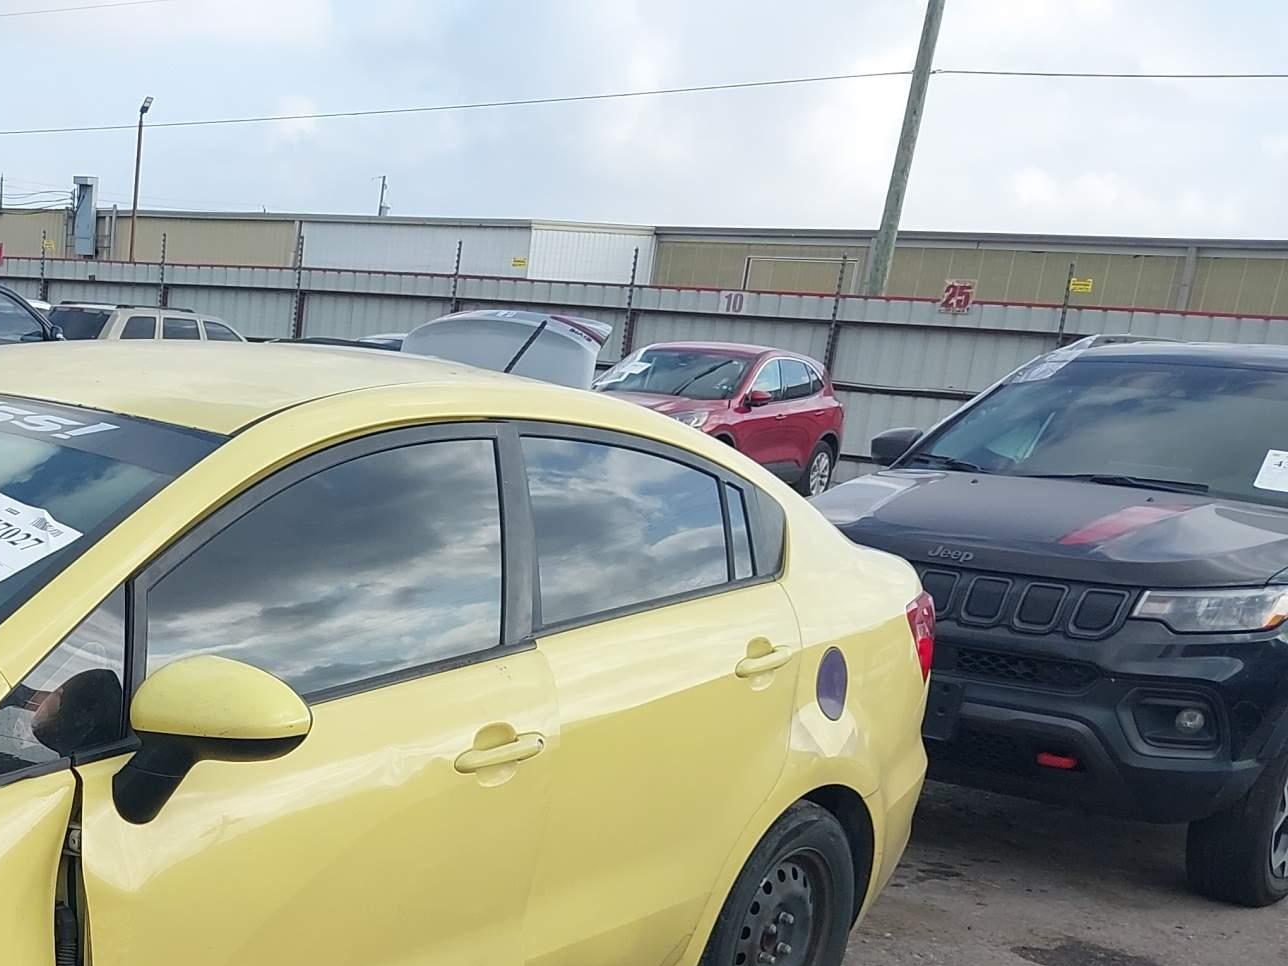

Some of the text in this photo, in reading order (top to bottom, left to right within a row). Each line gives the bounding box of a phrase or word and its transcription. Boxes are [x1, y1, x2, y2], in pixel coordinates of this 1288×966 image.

[725, 293, 744, 313] 10
[940, 284, 972, 311] 25
[927, 545, 974, 563] Jeep
